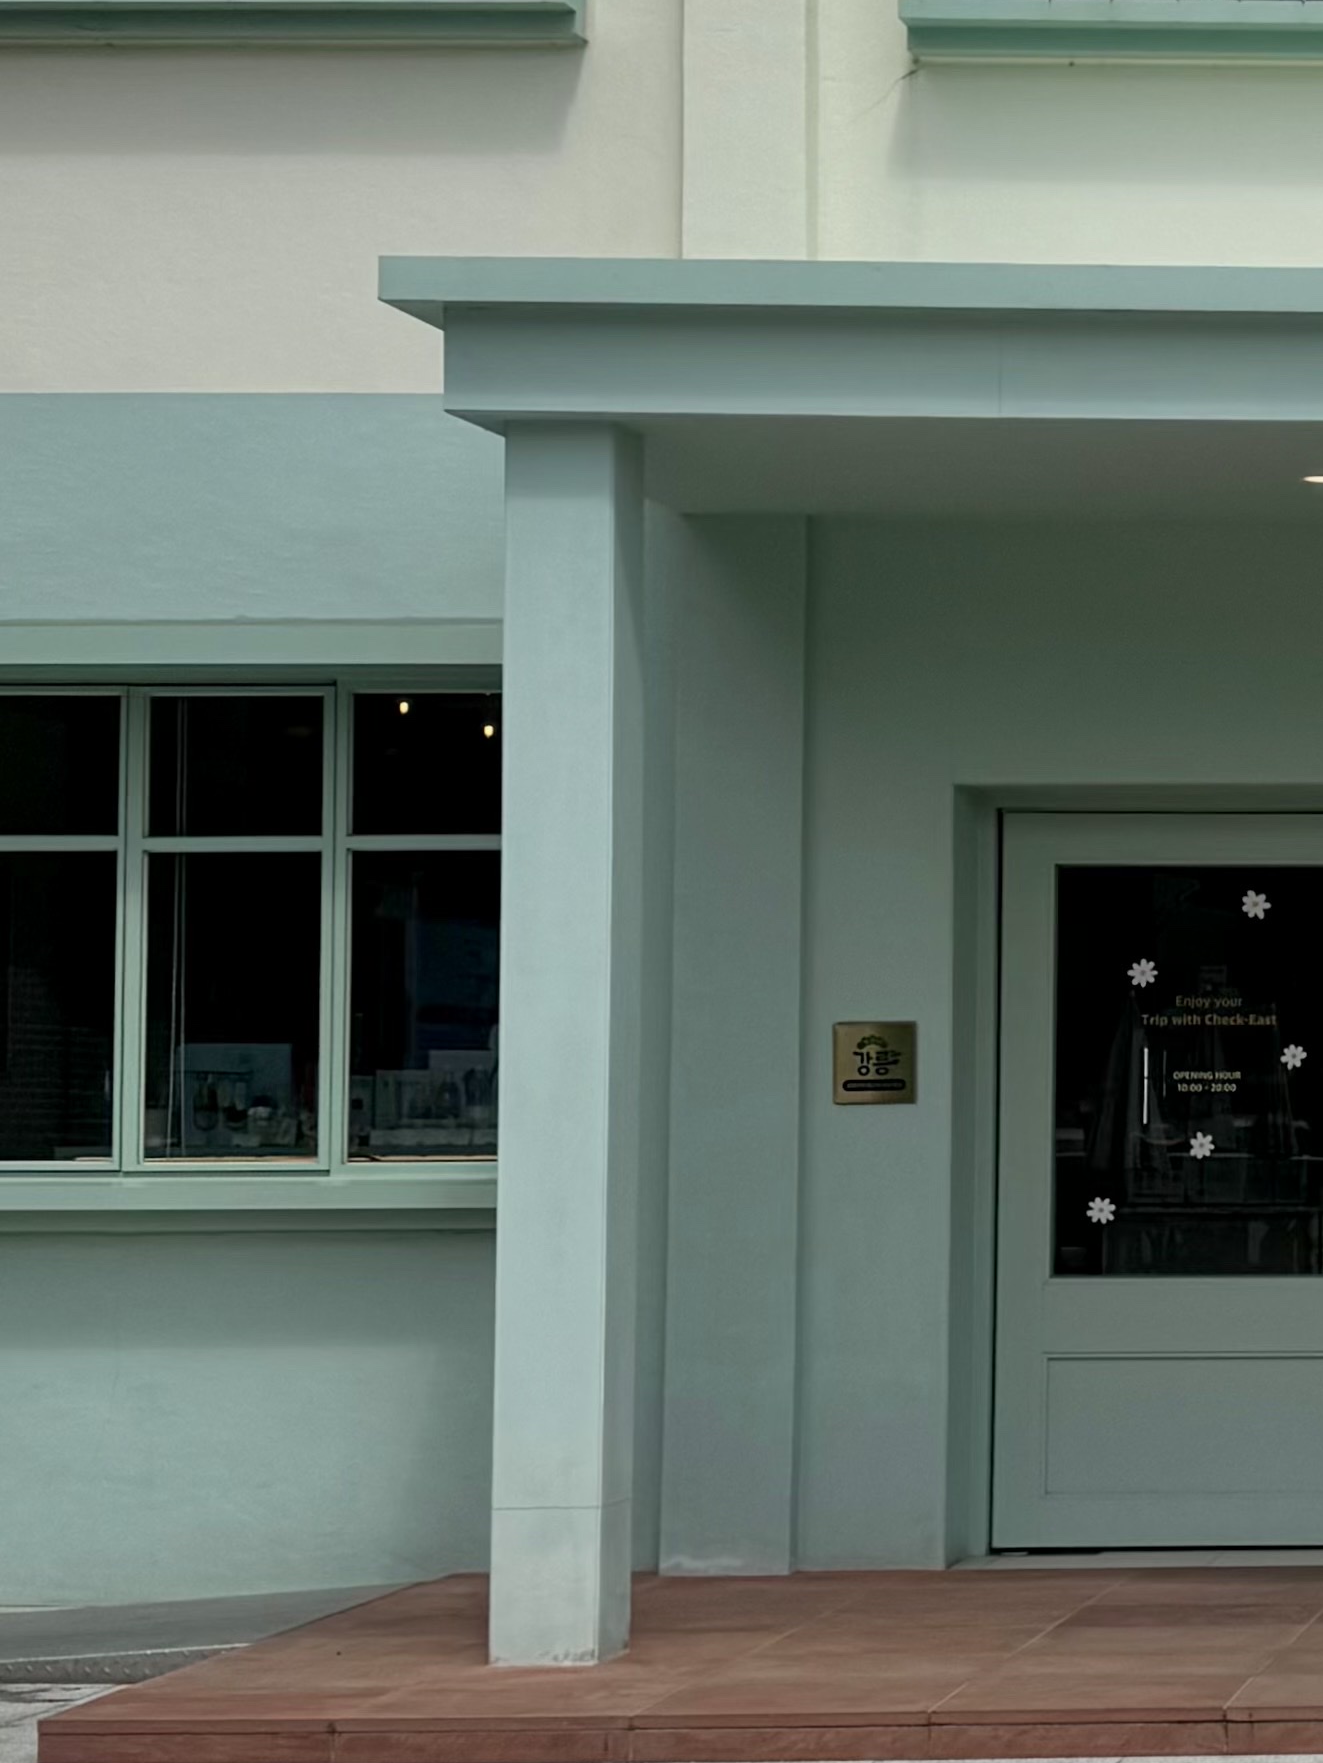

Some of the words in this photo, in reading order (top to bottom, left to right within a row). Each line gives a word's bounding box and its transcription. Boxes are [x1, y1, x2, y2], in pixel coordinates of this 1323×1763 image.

[1175, 995, 1211, 1009] Enjoy
[1214, 997, 1243, 1009] your
[1141, 1013, 1169, 1027] Trip
[1172, 1013, 1201, 1026] with
[1172, 1070, 1213, 1081] OPENING
[1215, 1070, 1242, 1081] HOUR
